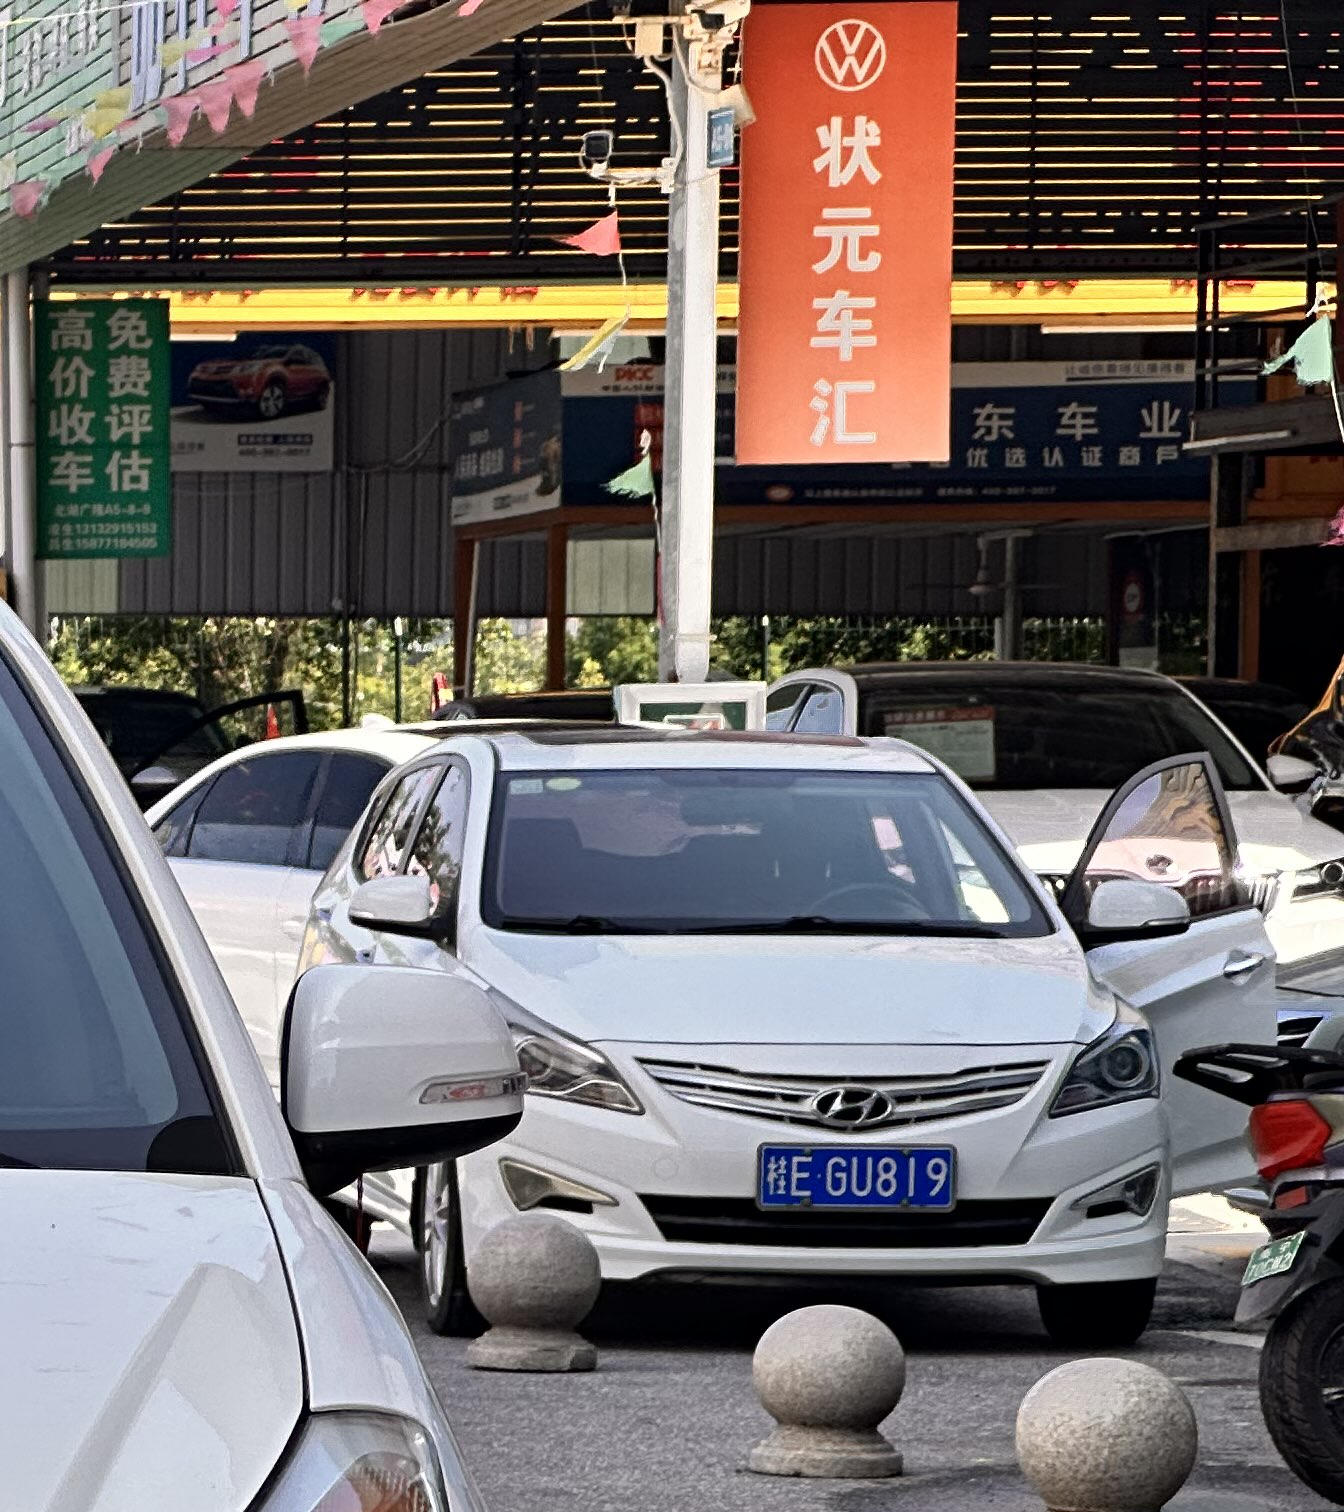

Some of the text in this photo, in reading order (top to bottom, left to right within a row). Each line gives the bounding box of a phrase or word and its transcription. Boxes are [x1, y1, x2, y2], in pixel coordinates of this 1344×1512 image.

[810, 115, 882, 446] 状元车汇
[47, 308, 95, 494] 高价收车
[104, 307, 153, 493] 免费评估
[891, 447, 1180, 470] 优选认证商户
